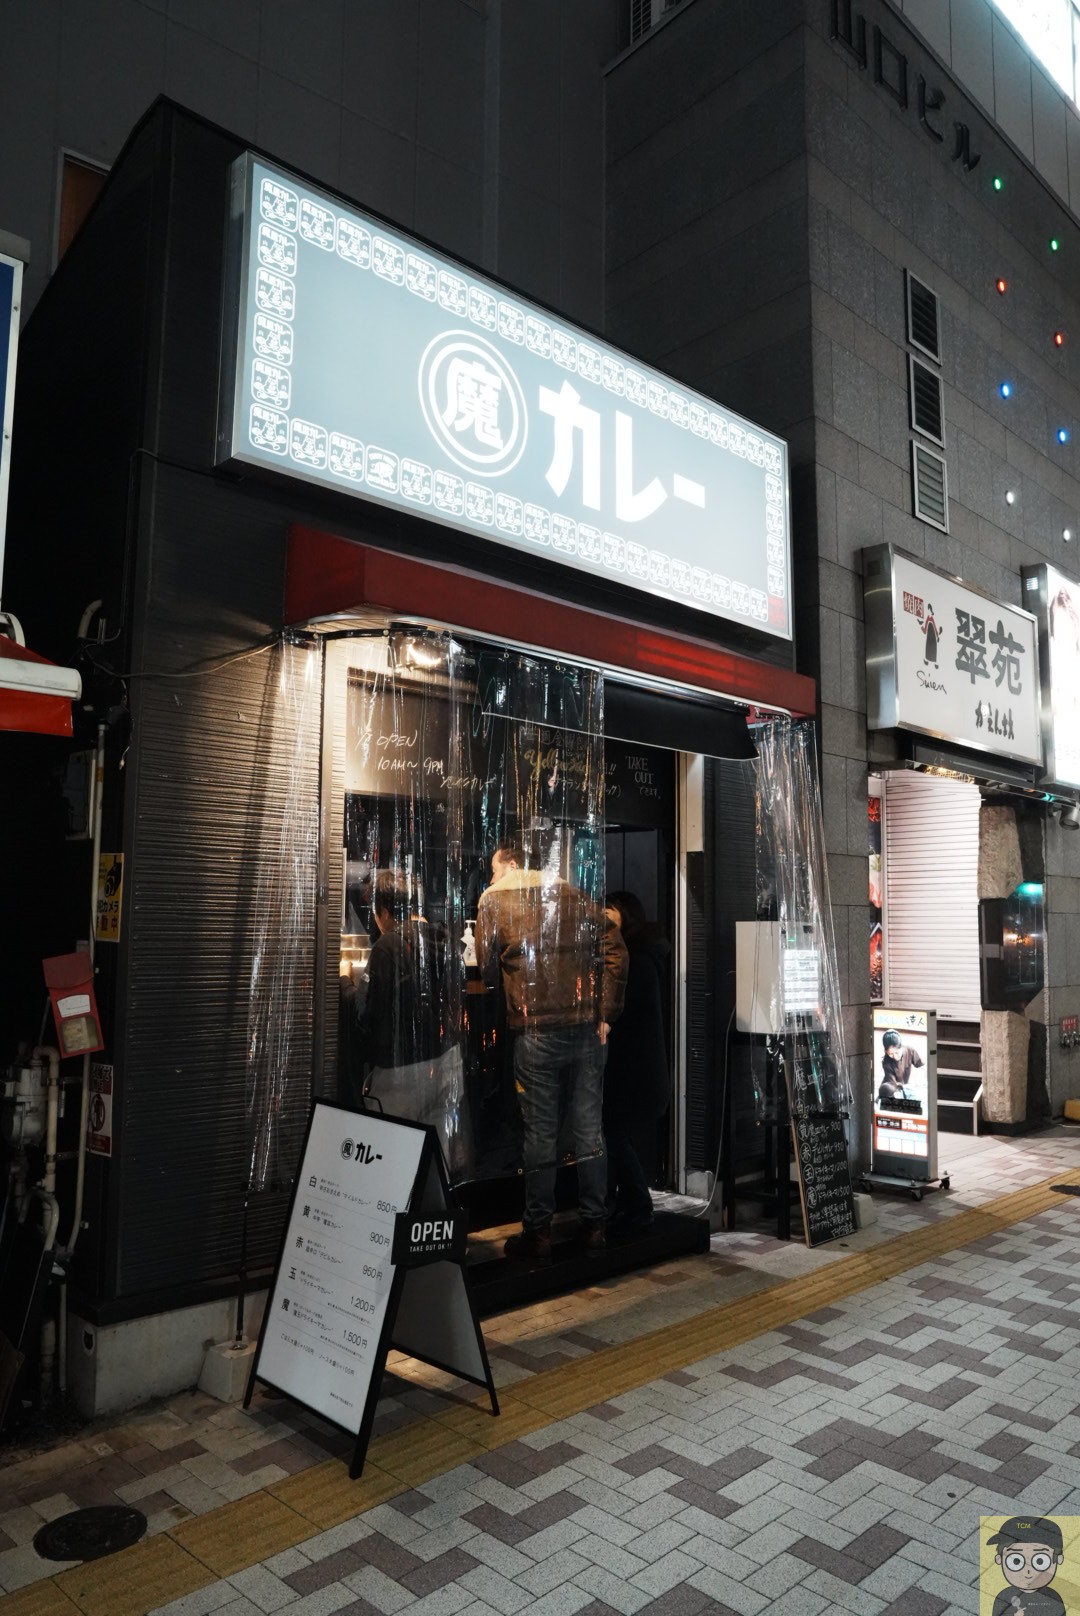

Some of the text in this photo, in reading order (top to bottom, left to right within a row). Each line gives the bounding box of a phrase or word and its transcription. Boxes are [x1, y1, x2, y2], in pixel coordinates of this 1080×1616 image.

[955, 608, 1026, 696] 翠苑
[377, 729, 418, 751] OPEN
[626, 755, 649, 771] TAKE
[634, 772, 655, 785] OUT
[309, 1176, 317, 1188] 白
[302, 1205, 311, 1218] 黄
[411, 1220, 454, 1242] OPEN
[295, 1236, 304, 1248] 赤
